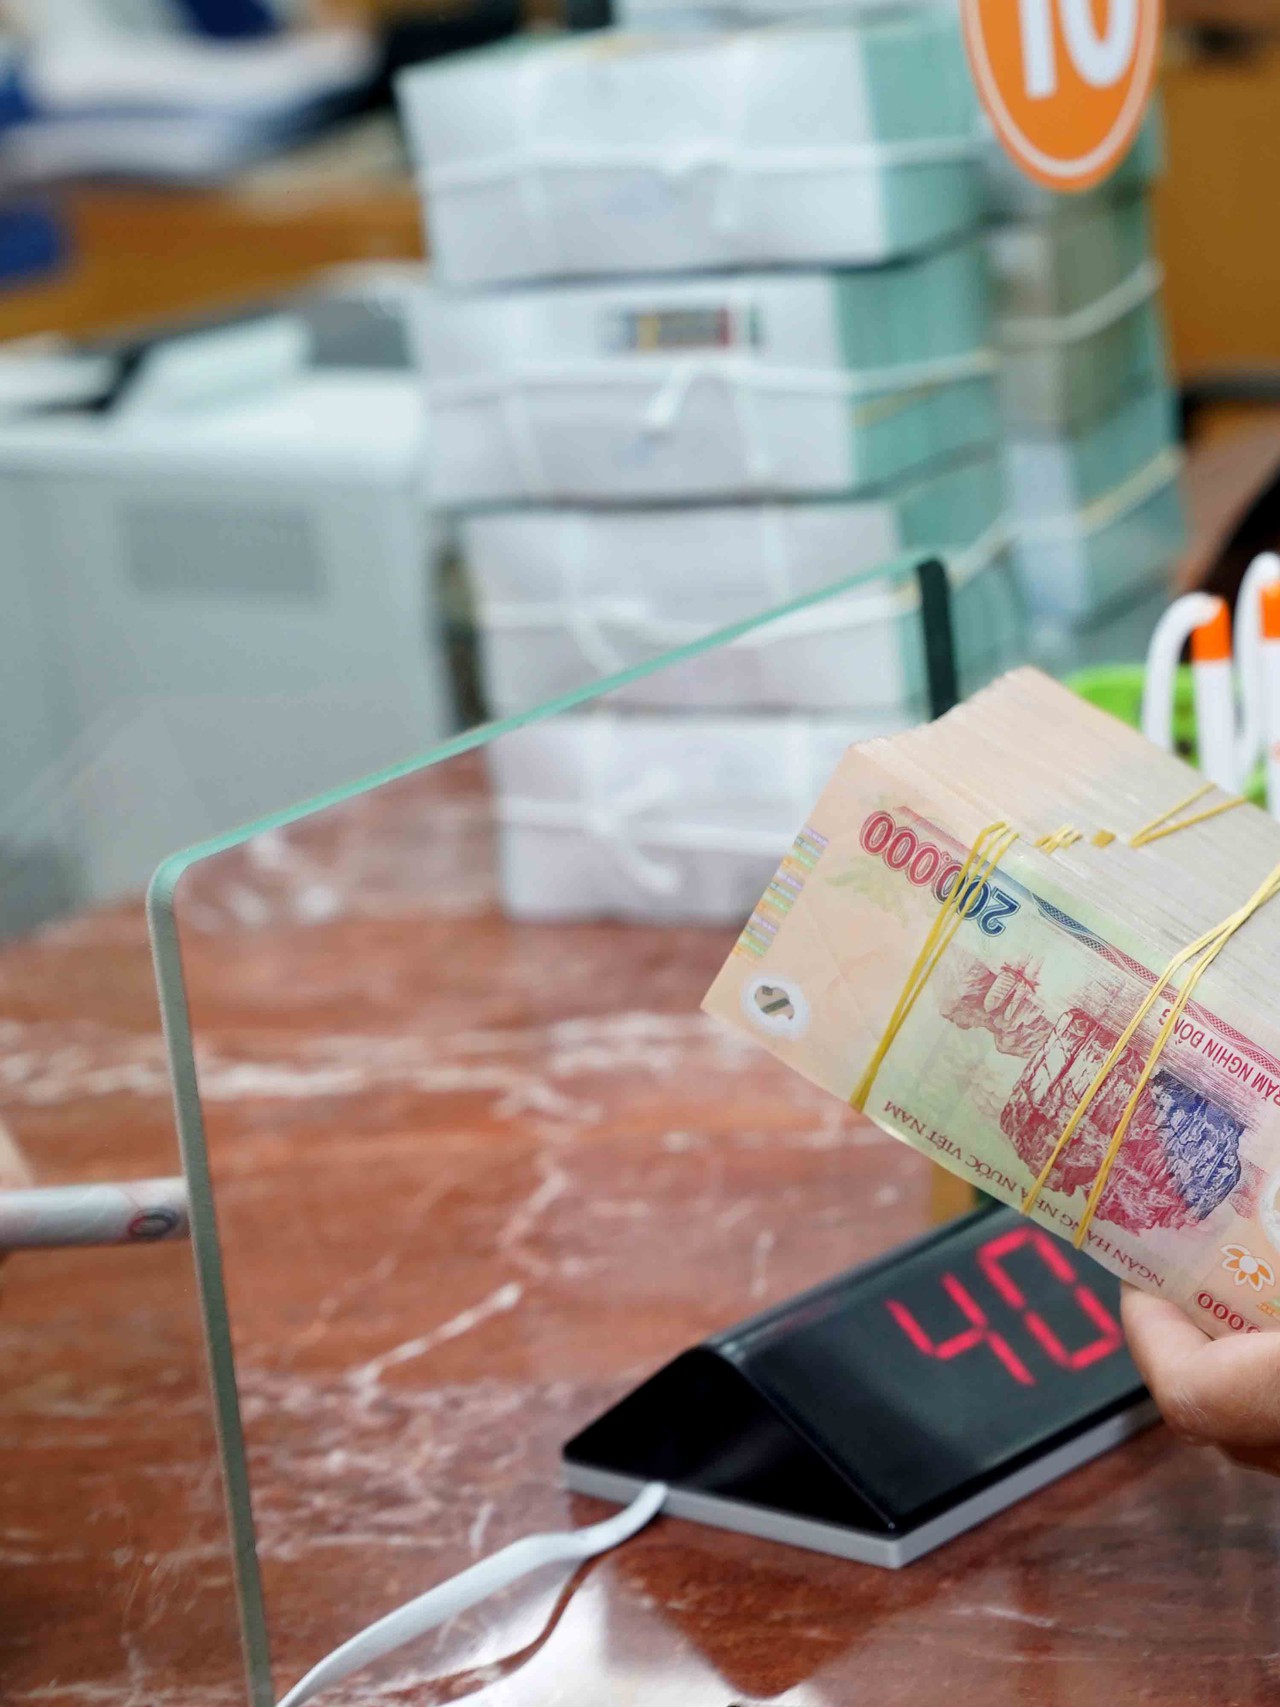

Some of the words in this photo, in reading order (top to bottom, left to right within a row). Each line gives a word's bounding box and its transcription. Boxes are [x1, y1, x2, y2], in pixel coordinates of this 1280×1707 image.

[859, 810, 1021, 937] 200.000
[1201, 1038, 1254, 1082] NGHÌN
[883, 1100, 927, 1135] NAM
[925, 1131, 962, 1160] VIỆT
[964, 1154, 1018, 1192] NƯỚC
[1112, 1249, 1165, 1288] NGÂN
[885, 1225, 1125, 1387] 40
